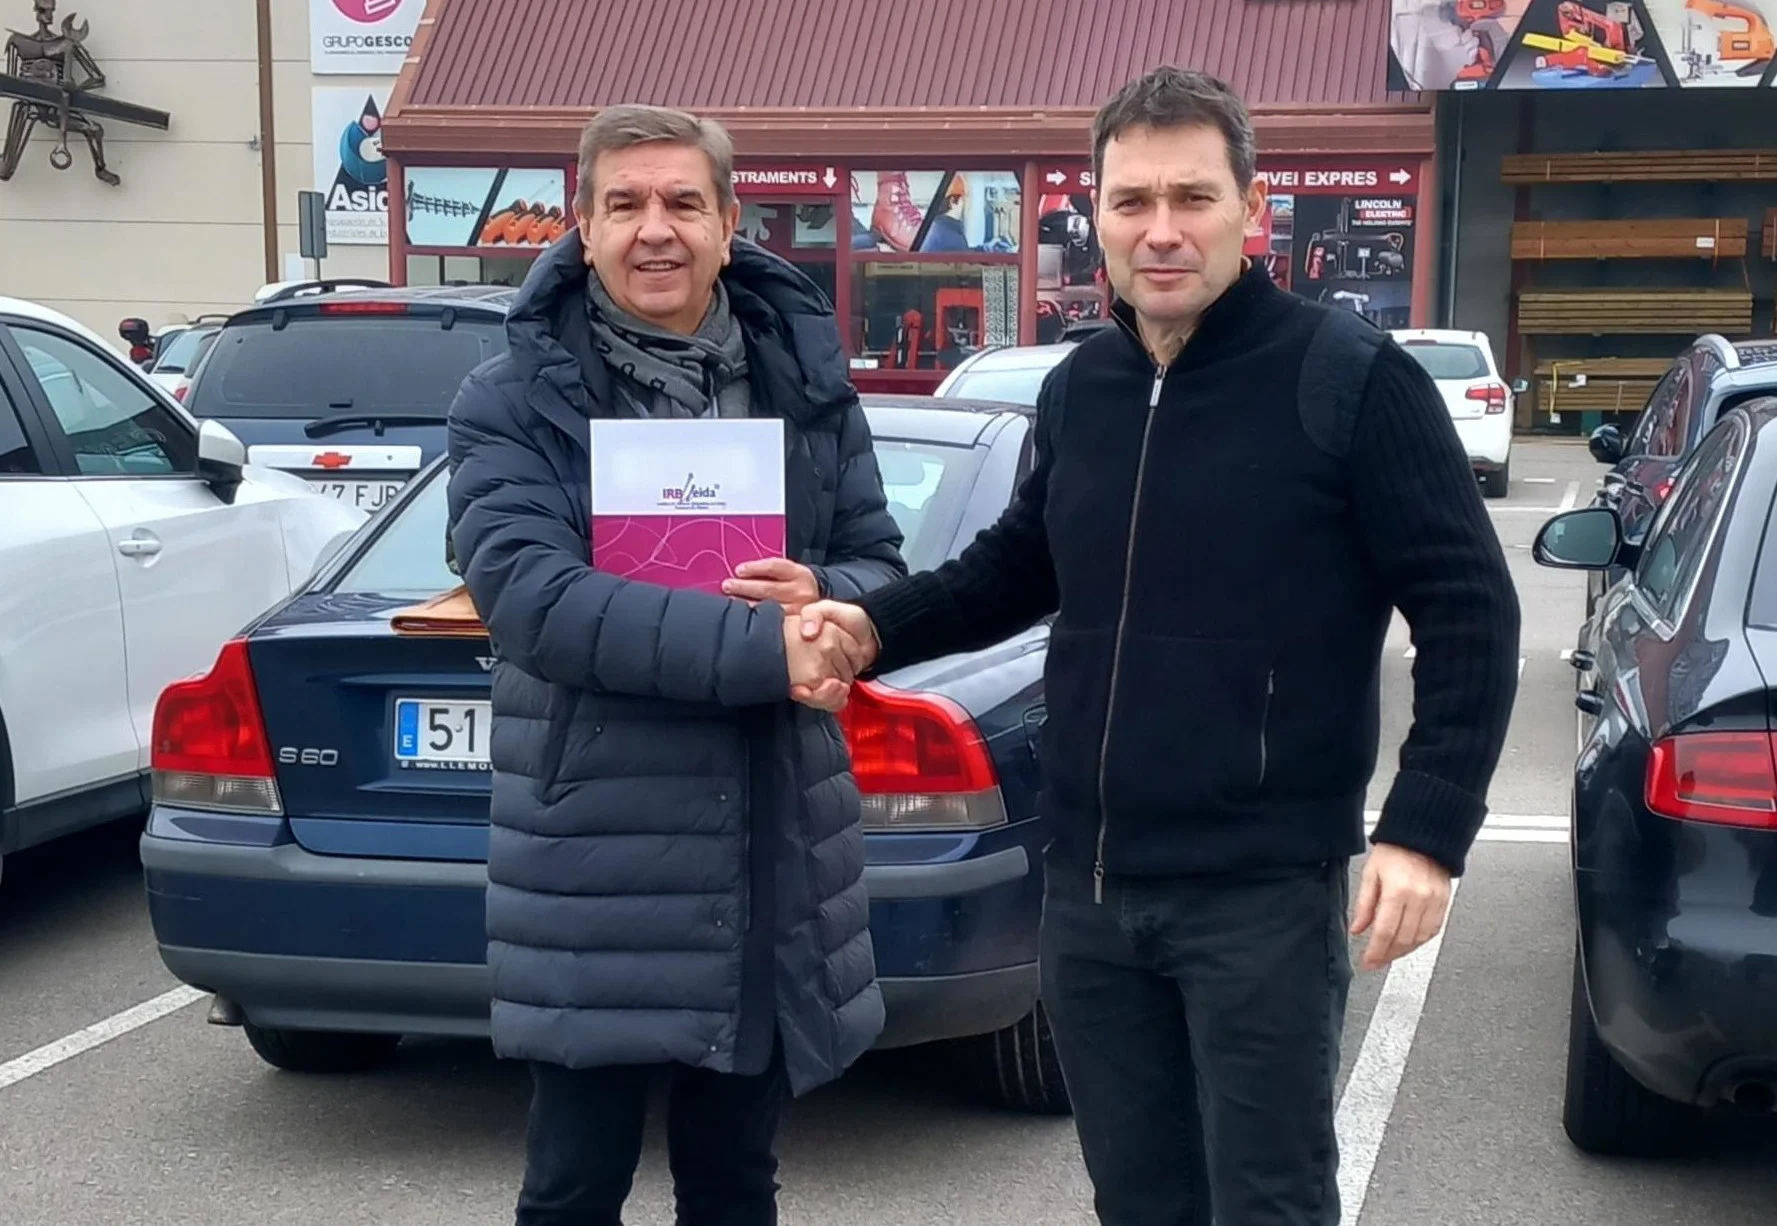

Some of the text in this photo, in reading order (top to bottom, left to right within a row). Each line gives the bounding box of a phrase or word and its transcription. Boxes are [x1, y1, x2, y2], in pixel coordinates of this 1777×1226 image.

[1304, 171, 1378, 186] EXPRES
[1355, 199, 1402, 209] LINCOLN
[403, 707, 476, 752] E 51
